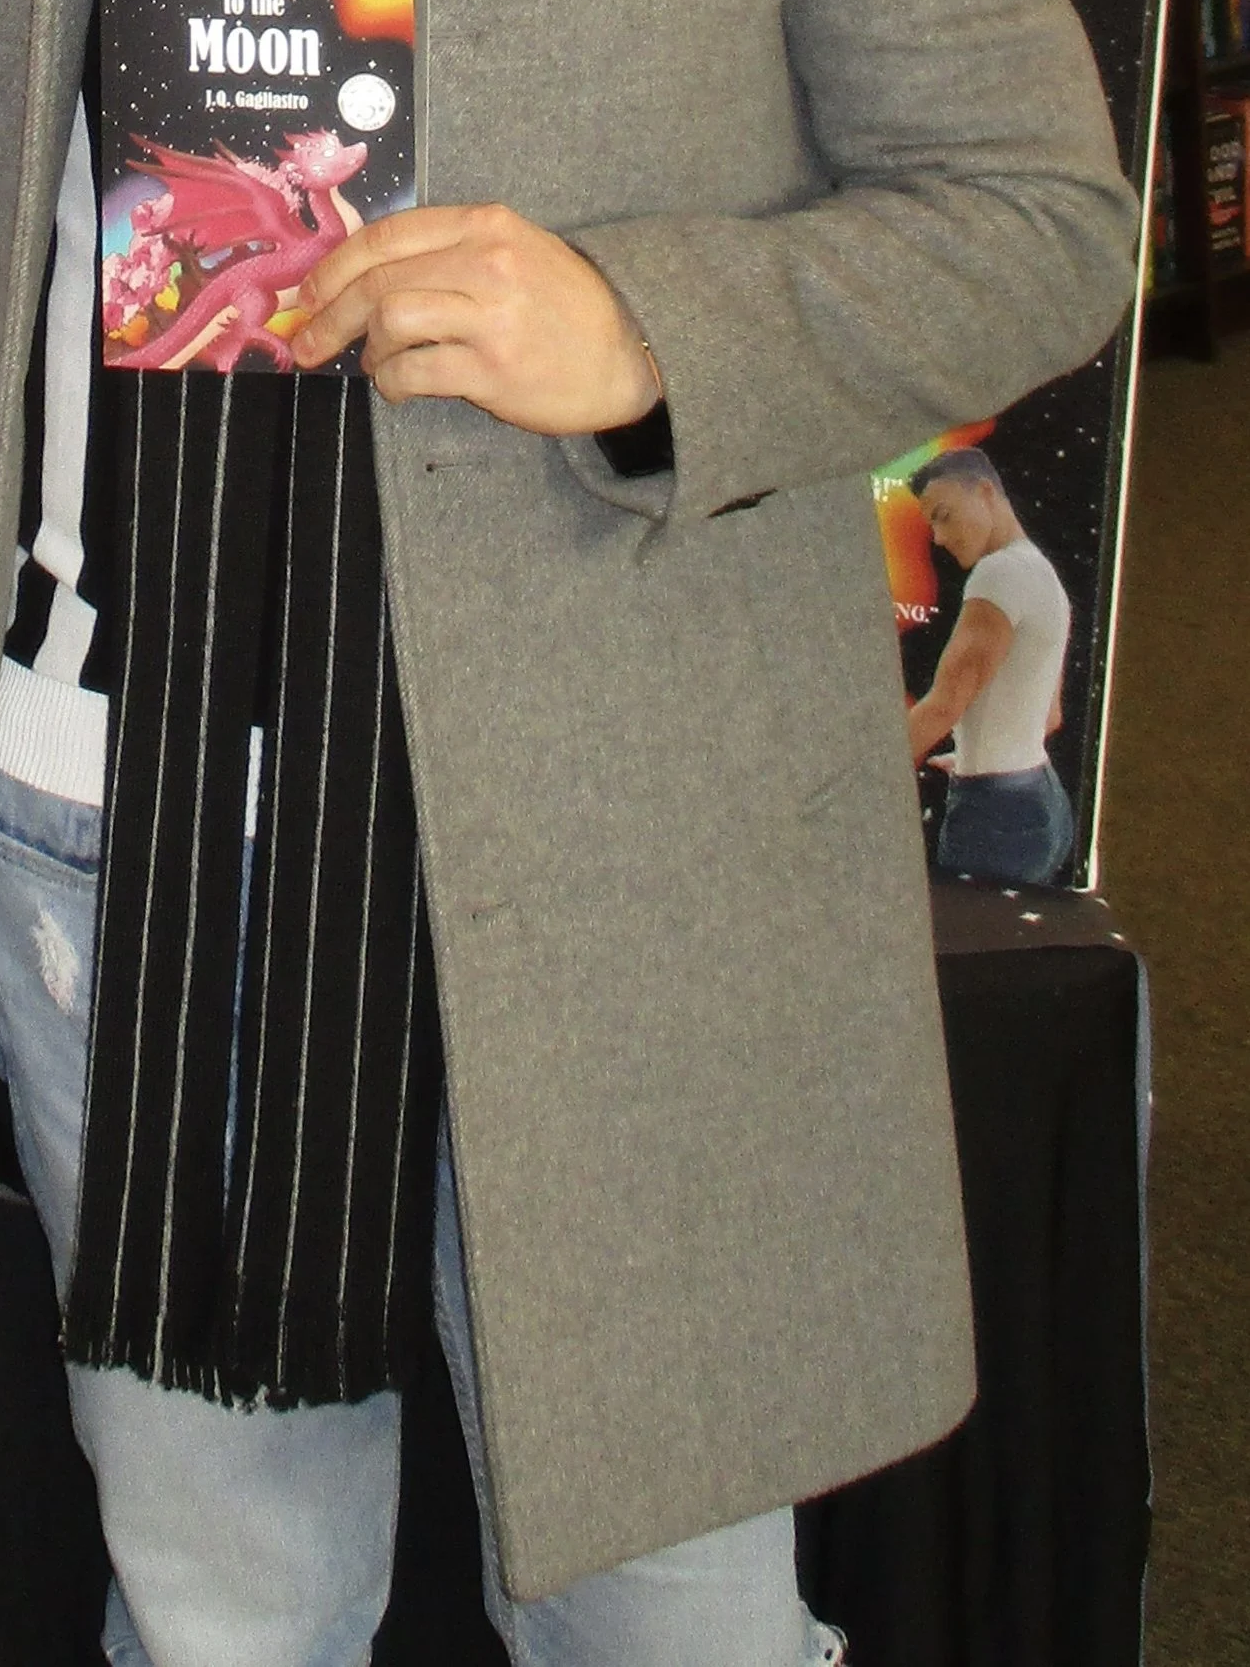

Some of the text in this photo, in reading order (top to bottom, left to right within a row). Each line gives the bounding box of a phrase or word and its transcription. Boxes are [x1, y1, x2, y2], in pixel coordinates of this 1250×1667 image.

[189, 17, 321, 78] Moon
[205, 90, 309, 113] J.Q. Gagliastro
